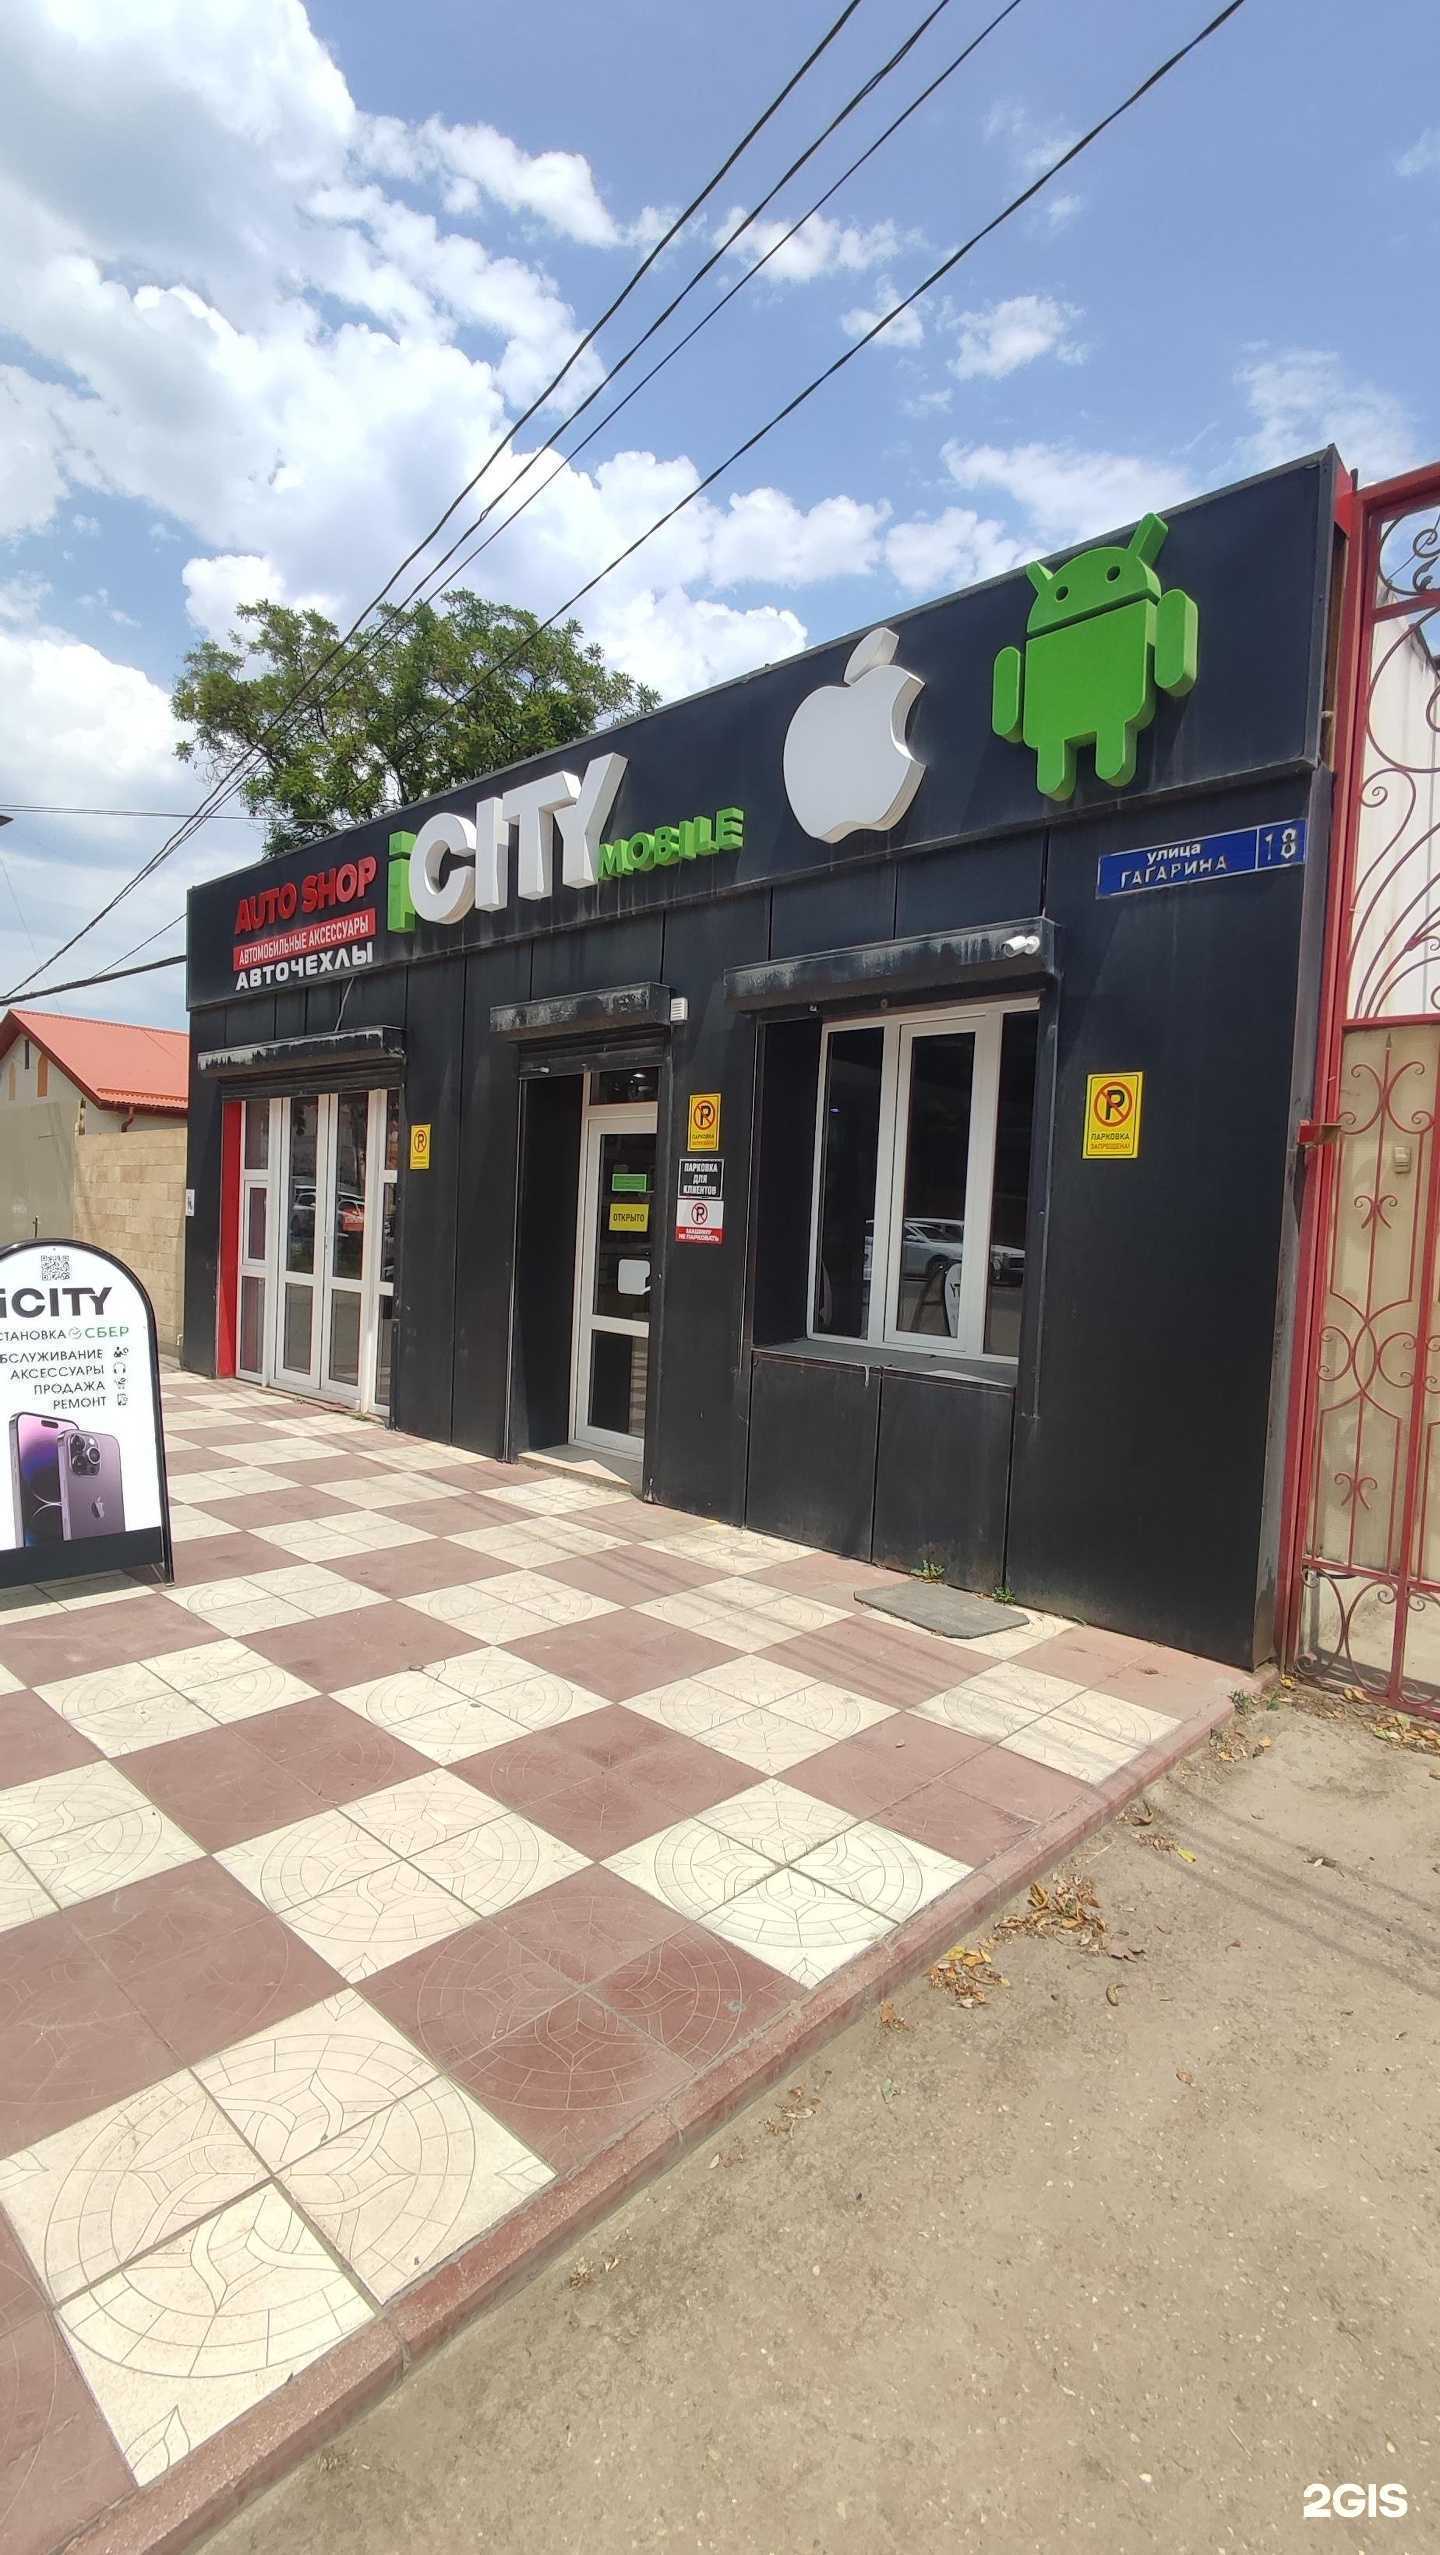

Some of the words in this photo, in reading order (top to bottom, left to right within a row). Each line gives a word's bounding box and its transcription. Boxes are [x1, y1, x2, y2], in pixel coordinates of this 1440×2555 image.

[599, 807, 744, 881] MOBILE
[1264, 827, 1297, 861] 18
[1147, 842, 1201, 866] улица
[1120, 855, 1228, 889] ГАГАРИНА
[235, 882, 298, 935] AUTO
[302, 856, 377, 913] SHOP
[239, 932, 307, 966] АВТОМОБИЛЬНЫЕ
[308, 915, 369, 947] АКСЕССУАРЫ
[235, 942, 374, 991] АВТОЧЕХЛЫ
[1091, 1132, 1129, 1140] ПАРКОВКА
[684, 1163, 718, 1173] ПАРКОВКА
[693, 1174, 708, 1184] ДЛЯ
[683, 1185, 717, 1195] КЛИЕНТОВ
[613, 1213, 645, 1222] ОТКРЫТО
[84, 1326, 129, 1339] СБЕР
[10, 1365, 104, 1380] АКСЕССУАРЫ
[34, 1381, 105, 1395] ПРОДАЖА
[53, 1396, 106, 1410] РЕМОНТ
